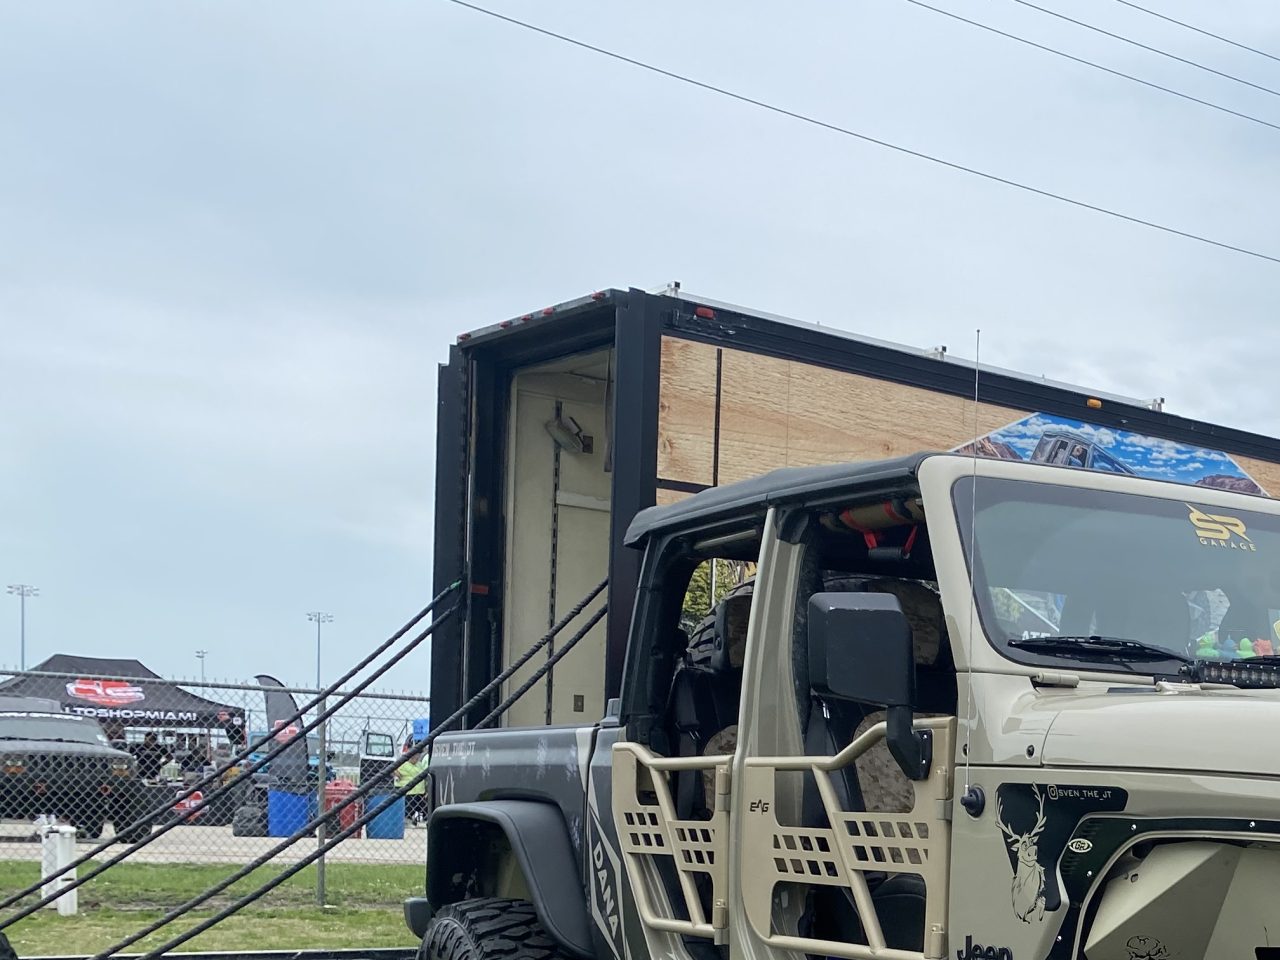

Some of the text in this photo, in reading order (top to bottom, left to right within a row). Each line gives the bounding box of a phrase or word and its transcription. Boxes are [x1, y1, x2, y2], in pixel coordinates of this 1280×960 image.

[1199, 538, 1257, 552] GARAGE
[1058, 789, 1112, 801] SVEN_THE_JT
[593, 840, 619, 940] DANA
